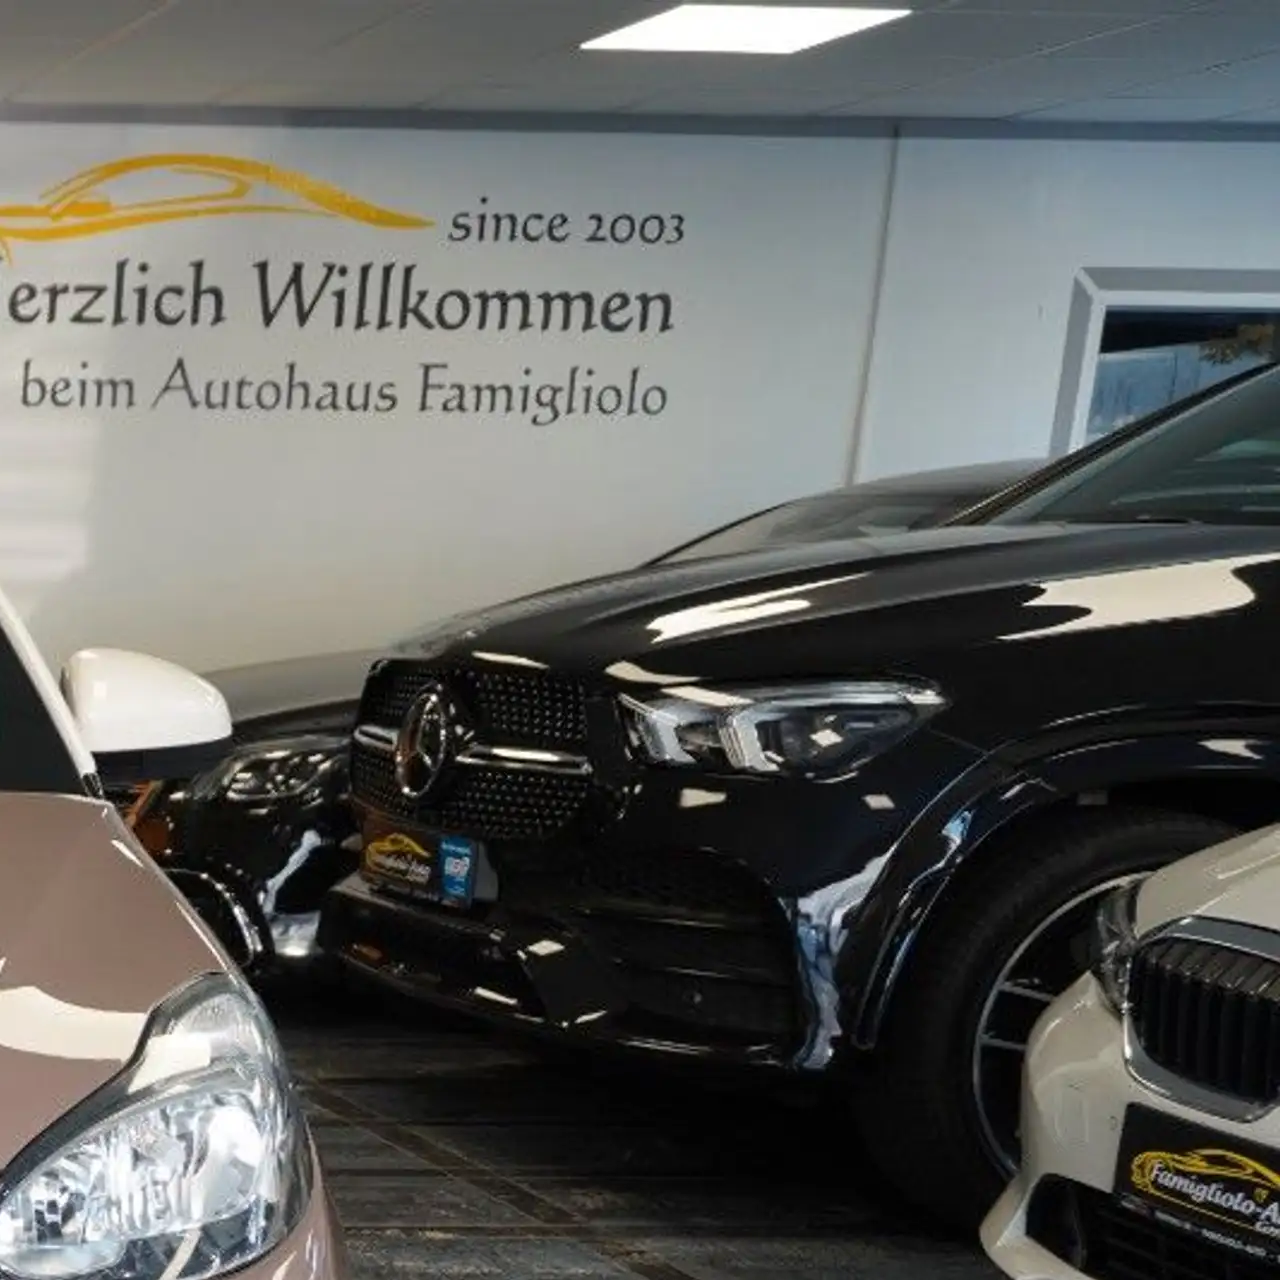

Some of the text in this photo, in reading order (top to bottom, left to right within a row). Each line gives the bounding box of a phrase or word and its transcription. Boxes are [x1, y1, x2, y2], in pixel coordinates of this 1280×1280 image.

[448, 195, 686, 245] since 2003
[250, 261, 674, 334] Willkommen
[20, 356, 669, 427] beim Autohaus Famigliolo
[1149, 1159, 1280, 1224] Famigliolo-A
